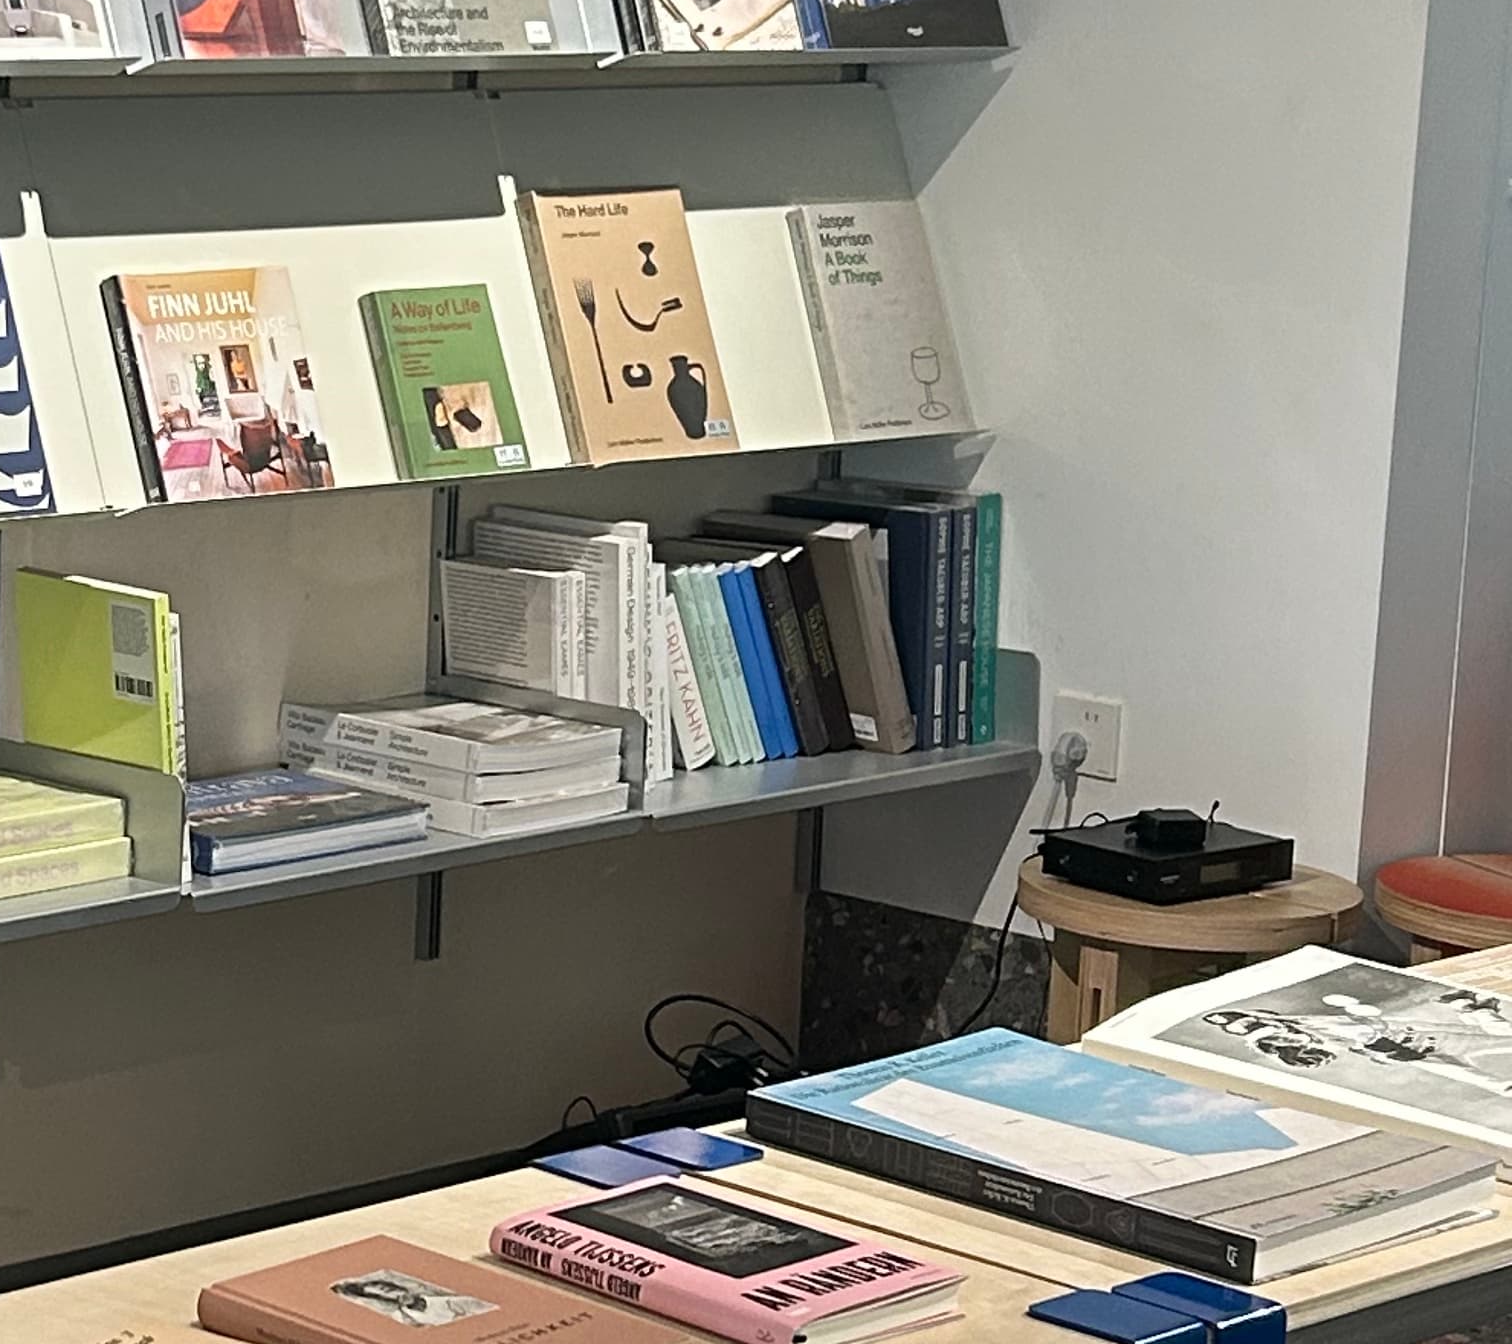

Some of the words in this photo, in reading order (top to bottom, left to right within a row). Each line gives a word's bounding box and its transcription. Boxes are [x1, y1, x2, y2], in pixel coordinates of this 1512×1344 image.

[466, 6, 489, 20] and
[554, 204, 577, 219] The
[578, 204, 606, 218] Hard
[606, 202, 629, 217] Life
[816, 214, 856, 232] Jasper
[819, 232, 875, 248] Morrison
[824, 253, 836, 268] A
[837, 250, 870, 267] Book
[827, 271, 841, 287] of
[843, 268, 885, 287] Things
[146, 292, 202, 320] FINN
[203, 290, 257, 317] JUHL
[391, 302, 403, 319] A
[402, 301, 433, 320] Way
[435, 299, 450, 317] of
[452, 297, 482, 316] Life
[154, 322, 195, 344] AND
[197, 322, 228, 340] HIS
[230, 316, 289, 338] HOUSE
[626, 546, 637, 598] German
[626, 598, 637, 645] Design
[665, 620, 691, 682] FRITZ
[678, 685, 706, 744] KAHN
[507, 1219, 583, 1253] ANGELO
[740, 1281, 796, 1312] AN
[784, 1250, 927, 1298] RÄNDERN
